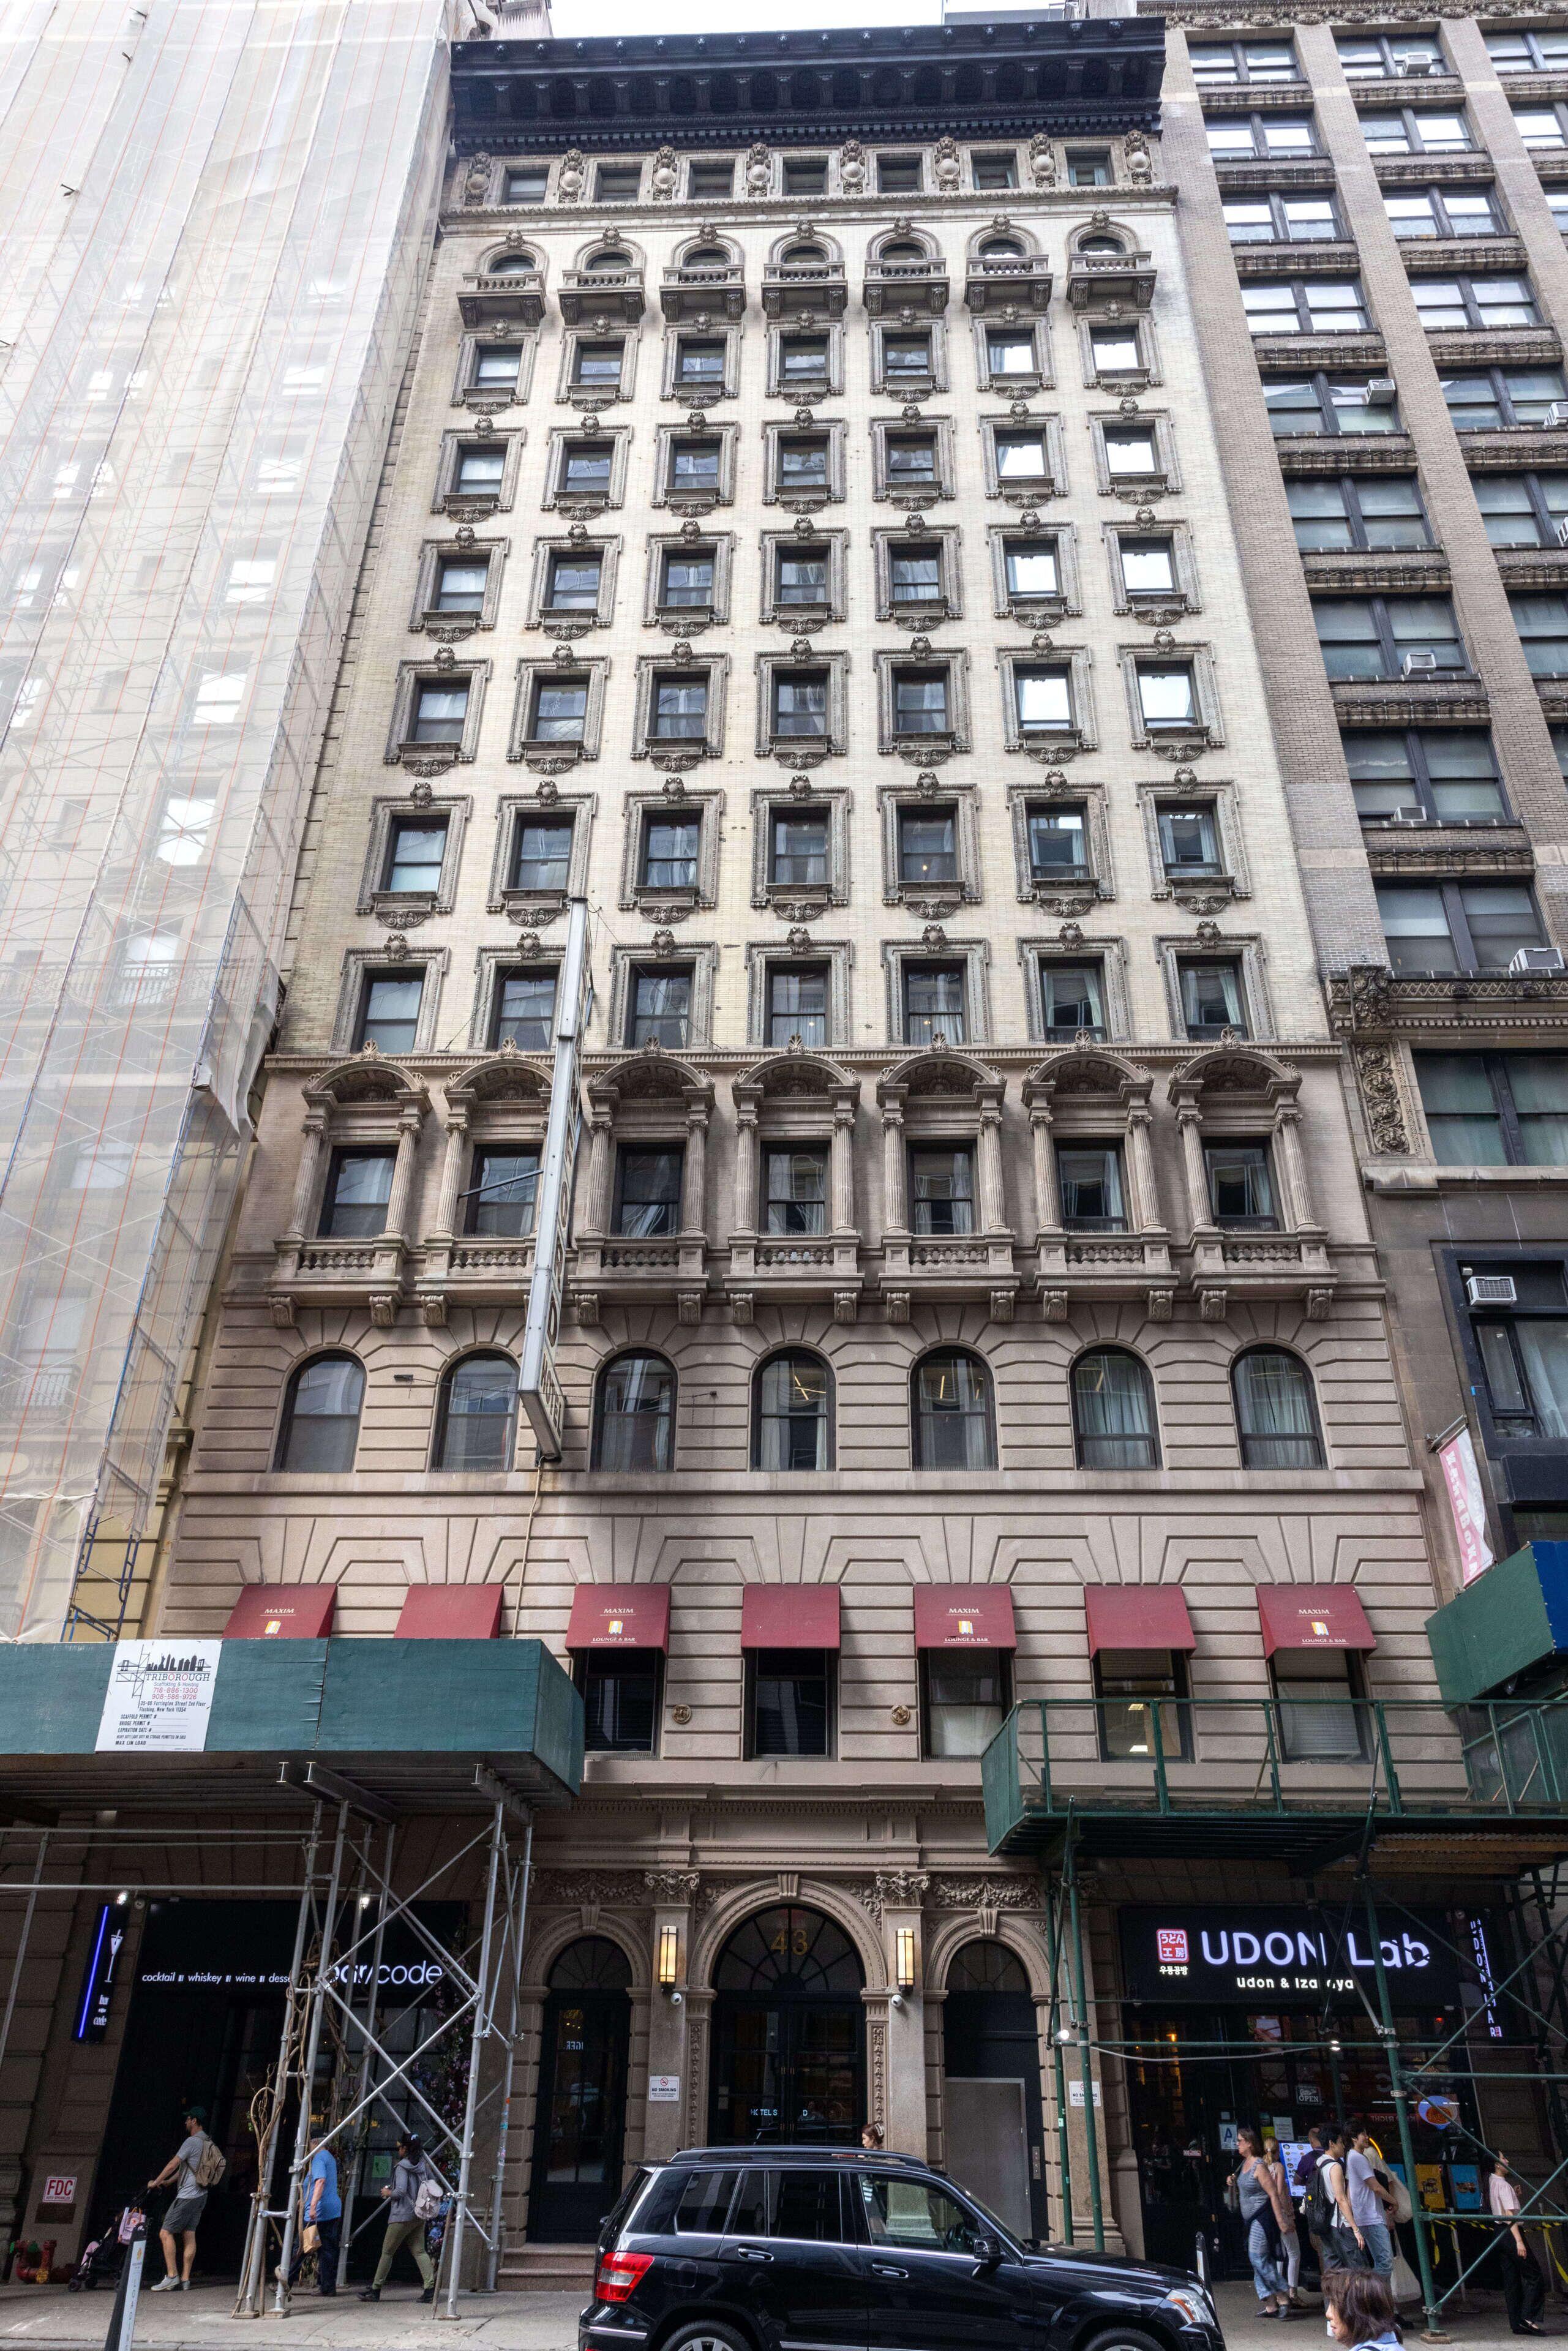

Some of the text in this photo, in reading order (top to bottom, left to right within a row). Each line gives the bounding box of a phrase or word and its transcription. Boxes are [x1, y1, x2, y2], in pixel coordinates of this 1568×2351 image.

[146, 1673, 210, 1681] TRIBOROUGH
[771, 1929, 808, 1955] 43
[1161, 1933, 1185, 1944] うどん
[1201, 1930, 1430, 1968] UDON Lab
[141, 1971, 176, 1982] cocktail
[187, 1971, 223, 1984] whiskey
[235, 1973, 257, 1983] wine
[268, 1973, 291, 1983] dess
[1236, 1976, 1354, 1992] Udon & Izaaya
[1224, 2128, 1232, 2142] A
[47, 2180, 73, 2196] FDC
